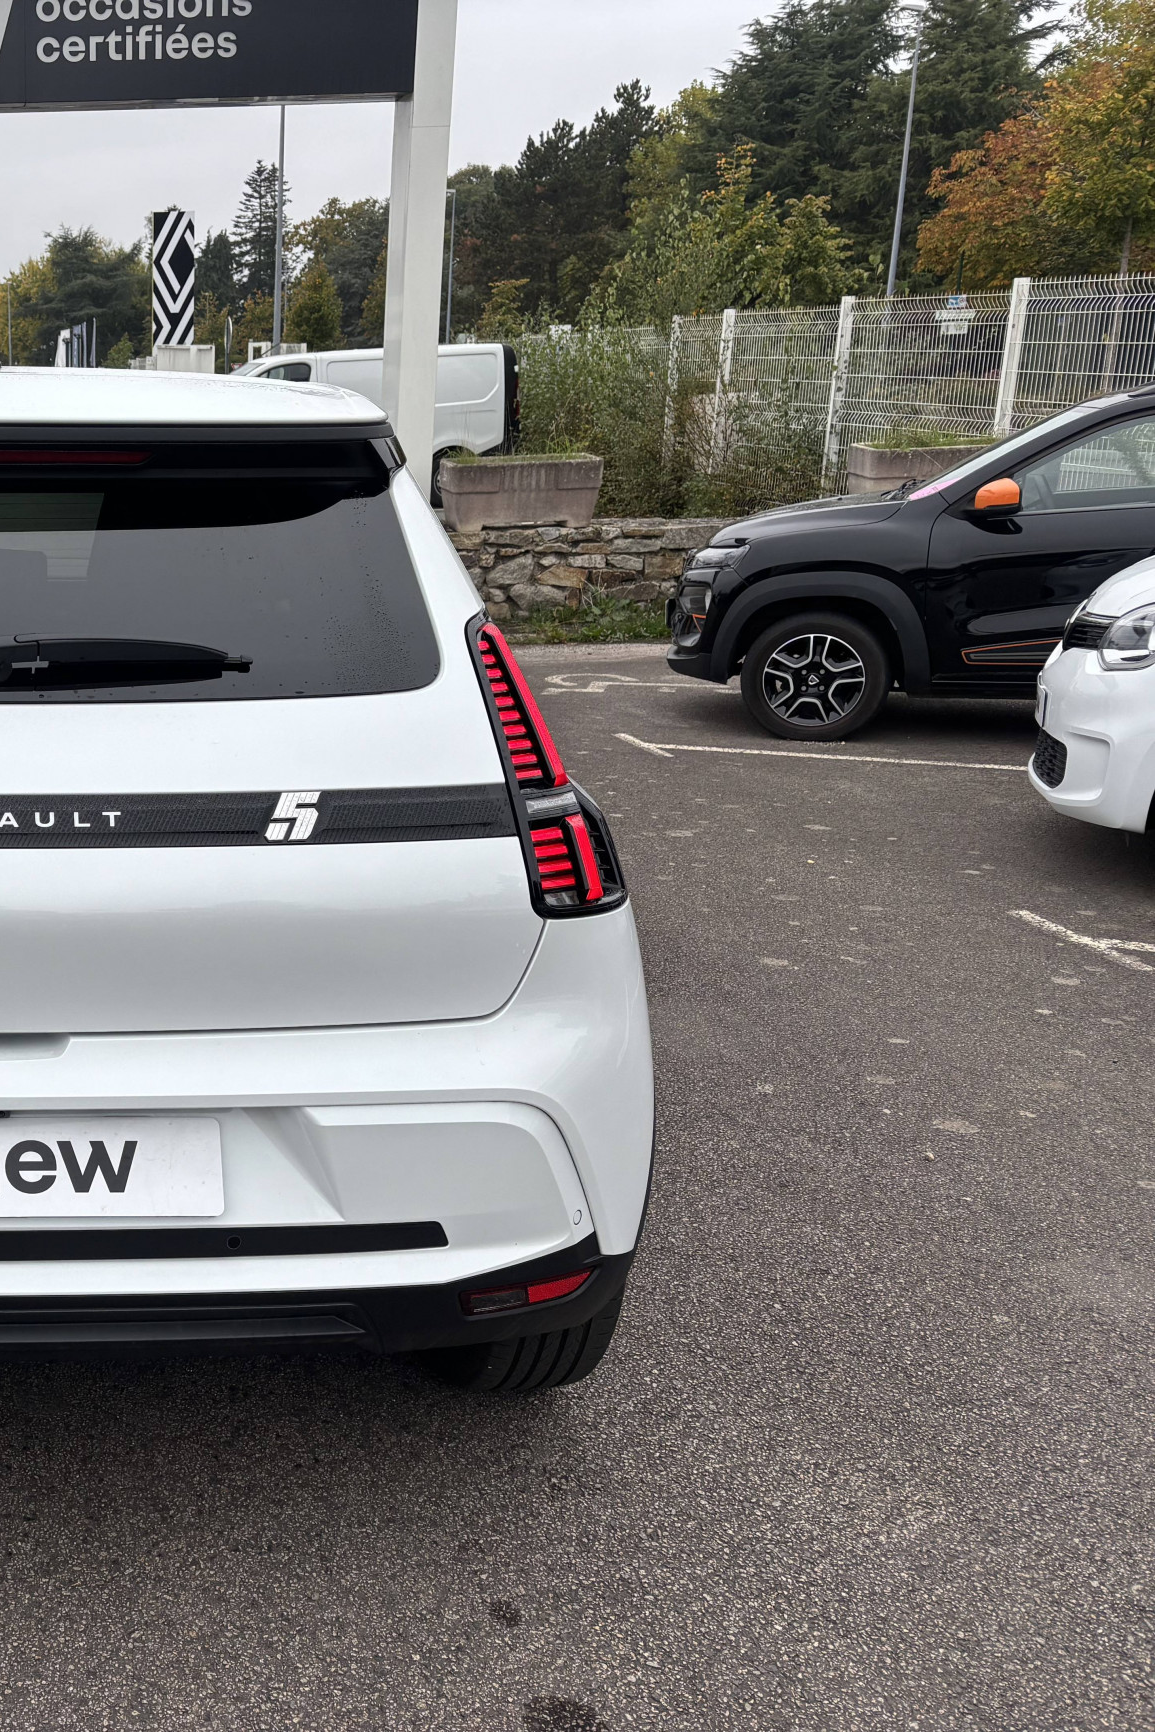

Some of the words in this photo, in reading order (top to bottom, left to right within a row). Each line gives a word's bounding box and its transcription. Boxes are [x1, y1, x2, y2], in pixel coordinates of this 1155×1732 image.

[35, 0, 253, 22] occasions
[36, 23, 237, 63] certifiées
[263, 791, 321, 843] 5
